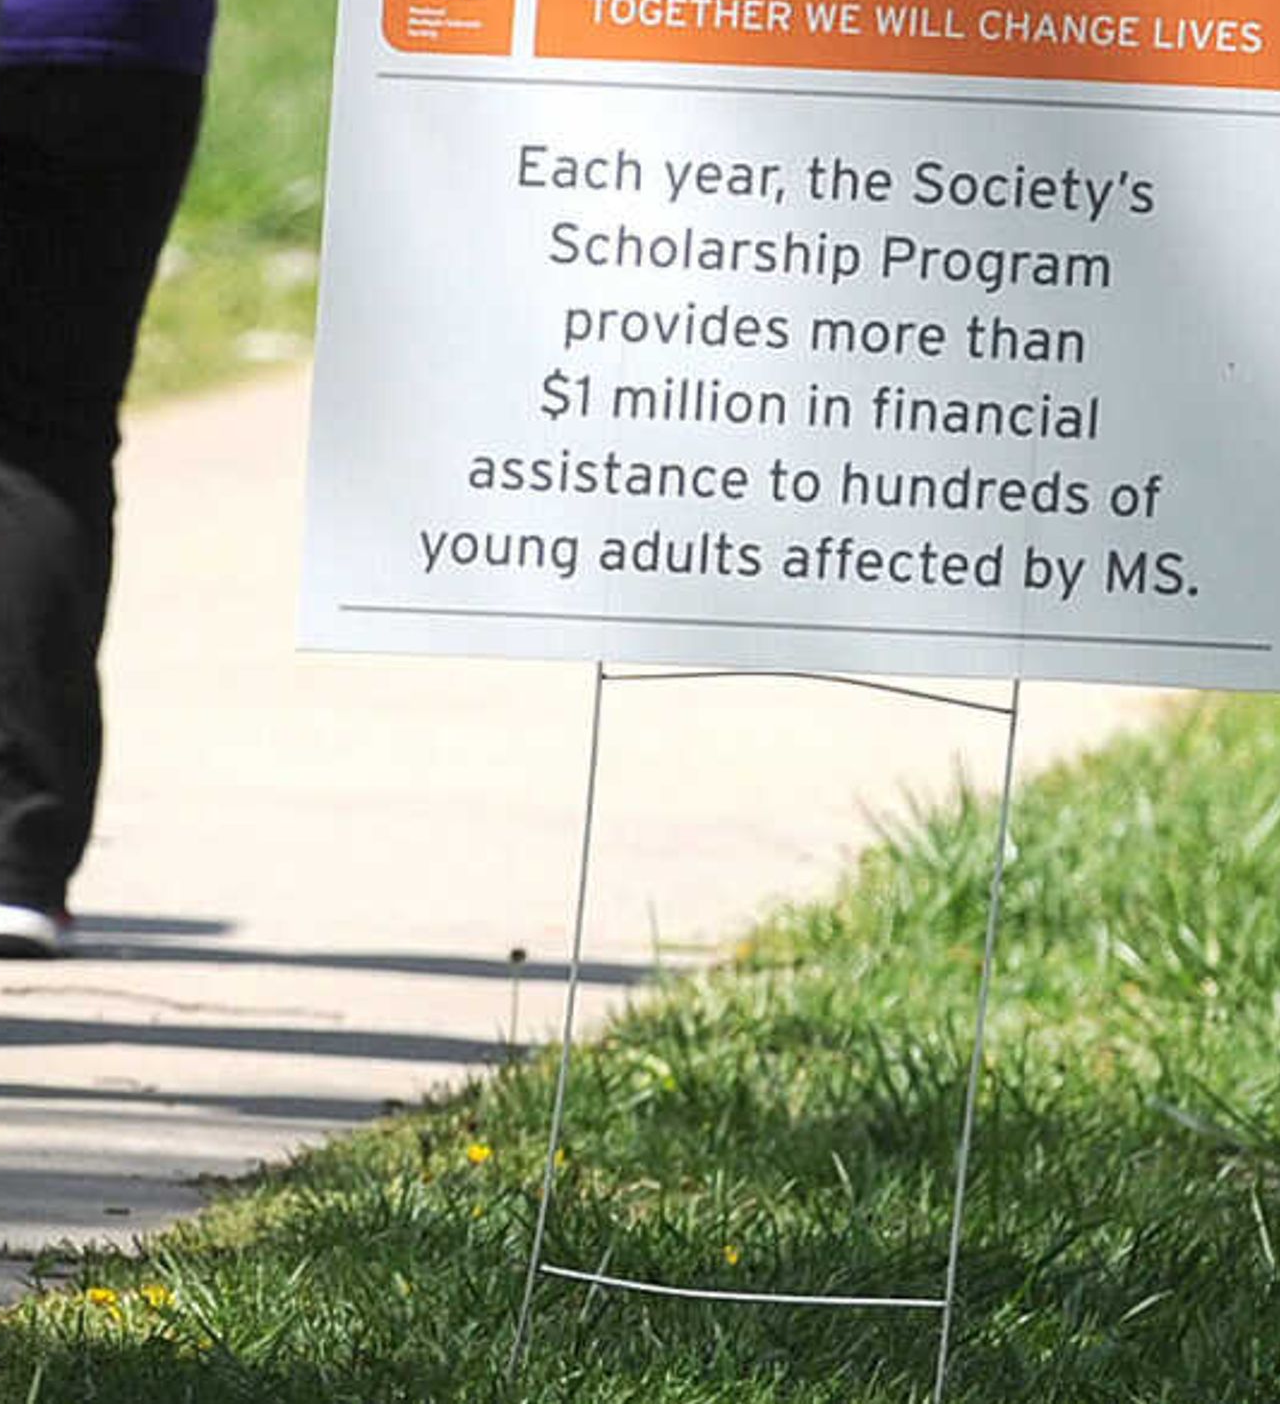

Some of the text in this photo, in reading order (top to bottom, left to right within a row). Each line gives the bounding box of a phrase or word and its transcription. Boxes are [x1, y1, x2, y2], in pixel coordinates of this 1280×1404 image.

[806, 3, 861, 34] WE
[876, 7, 963, 37] WILL
[980, 11, 1139, 47] CHANGE
[1154, 17, 1262, 53] LIVES
[517, 144, 1154, 223] Each year, the Society's
[548, 221, 1110, 294] Scholarship Program
[563, 301, 1084, 364] provides more than
[540, 367, 1099, 440] $1 million in financial
[468, 448, 1163, 518] assistance to hundreds of
[419, 529, 1199, 602] young adults affected by MS.
